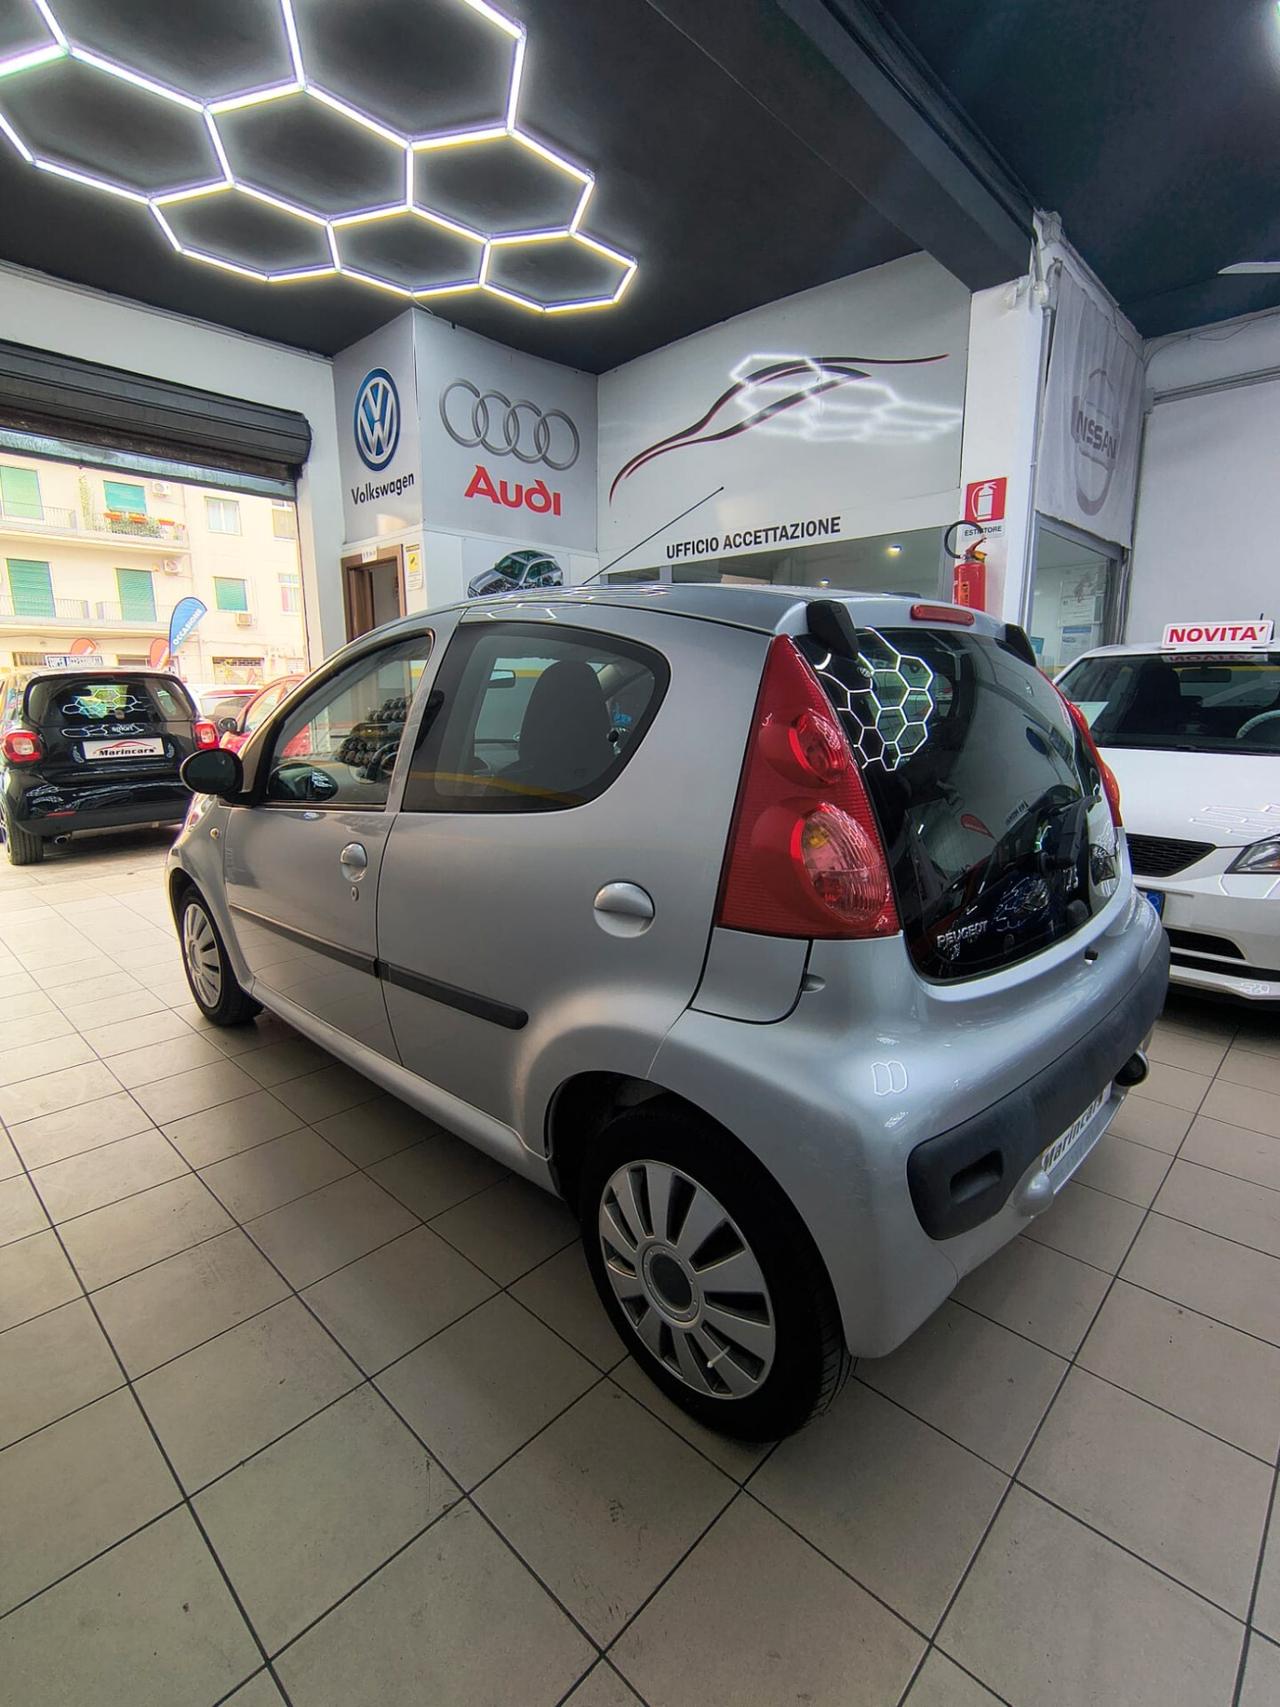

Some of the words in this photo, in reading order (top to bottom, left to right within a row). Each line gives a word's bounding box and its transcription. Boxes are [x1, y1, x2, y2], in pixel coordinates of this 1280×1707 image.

[351, 473, 415, 506] Volkswagen
[464, 464, 561, 517] Audi
[666, 537, 719, 559] UFFICIO
[723, 516, 841, 550] ACCETTAZIONE
[1168, 626, 1266, 643] NOVITA'
[100, 748, 156, 757] Marincars
[937, 920, 988, 947] PEUGEOT
